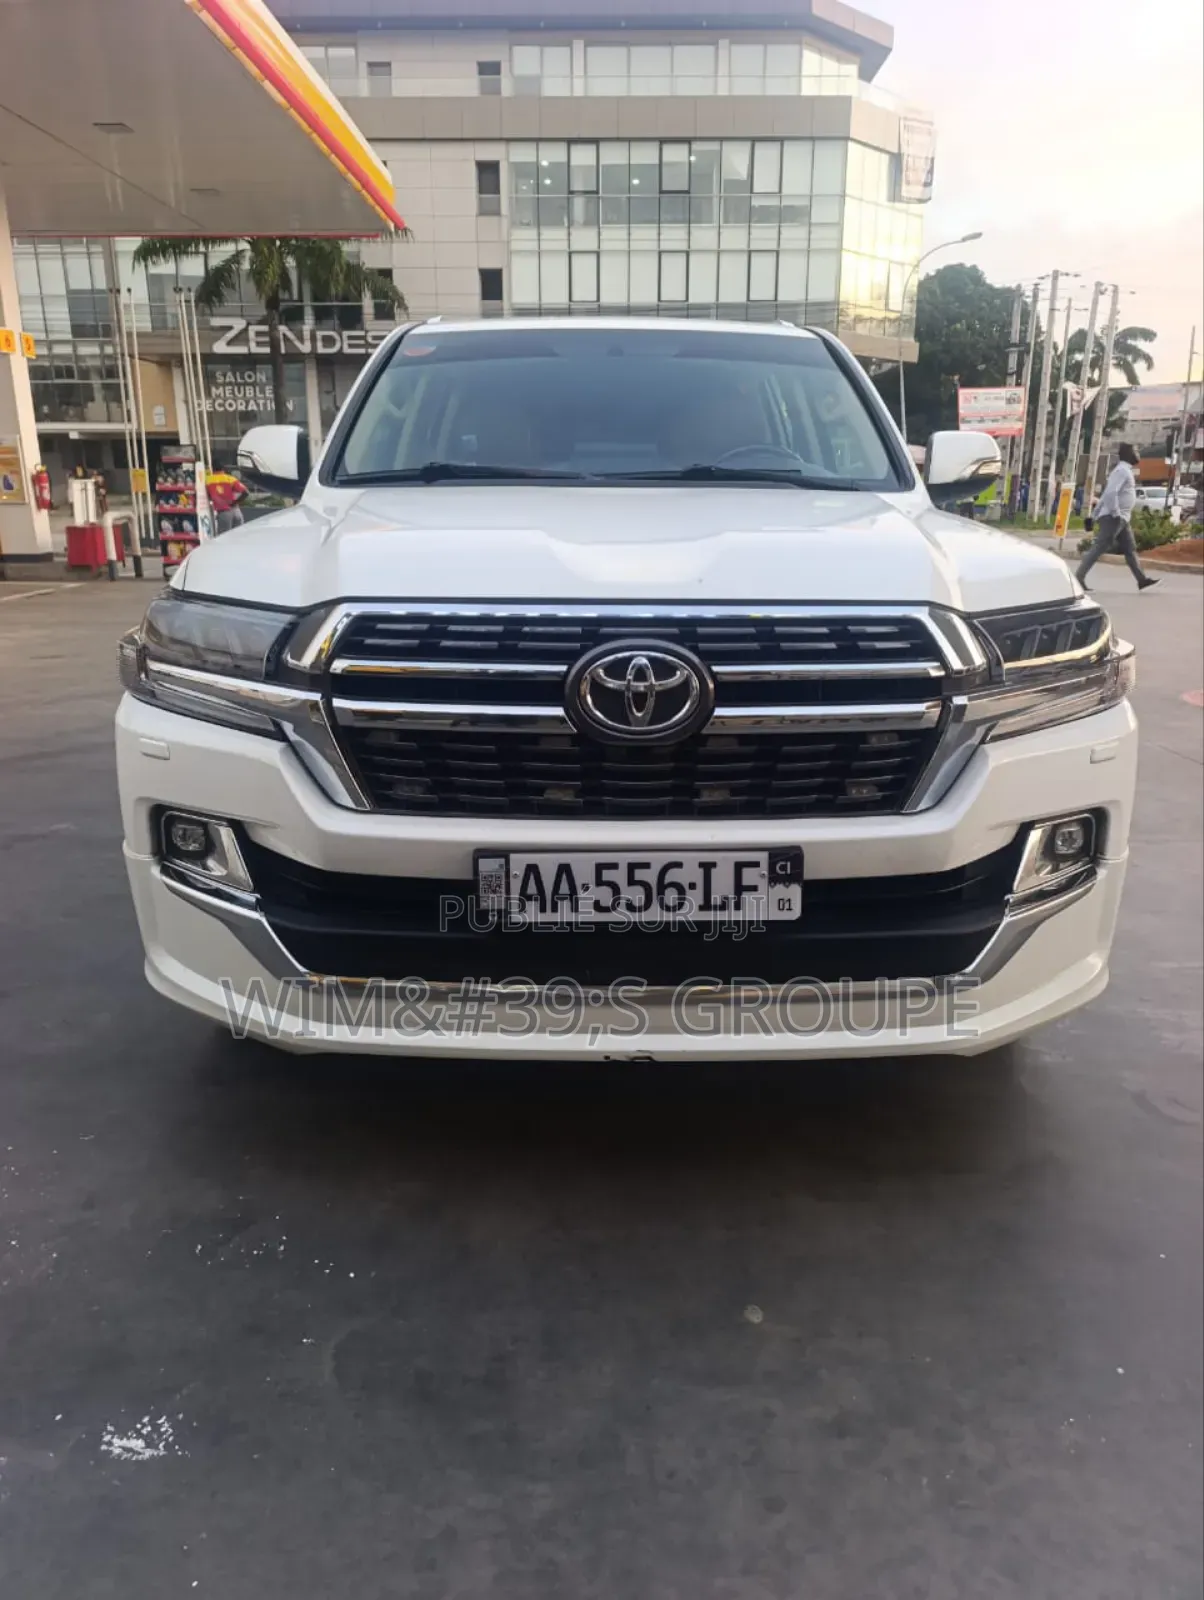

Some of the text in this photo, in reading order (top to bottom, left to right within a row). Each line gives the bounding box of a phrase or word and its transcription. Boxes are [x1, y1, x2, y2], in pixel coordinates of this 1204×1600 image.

[215, 371, 267, 383] SALON
[210, 385, 274, 398] MEUBLE
[776, 861, 791, 874] CI
[777, 898, 793, 911] 01
